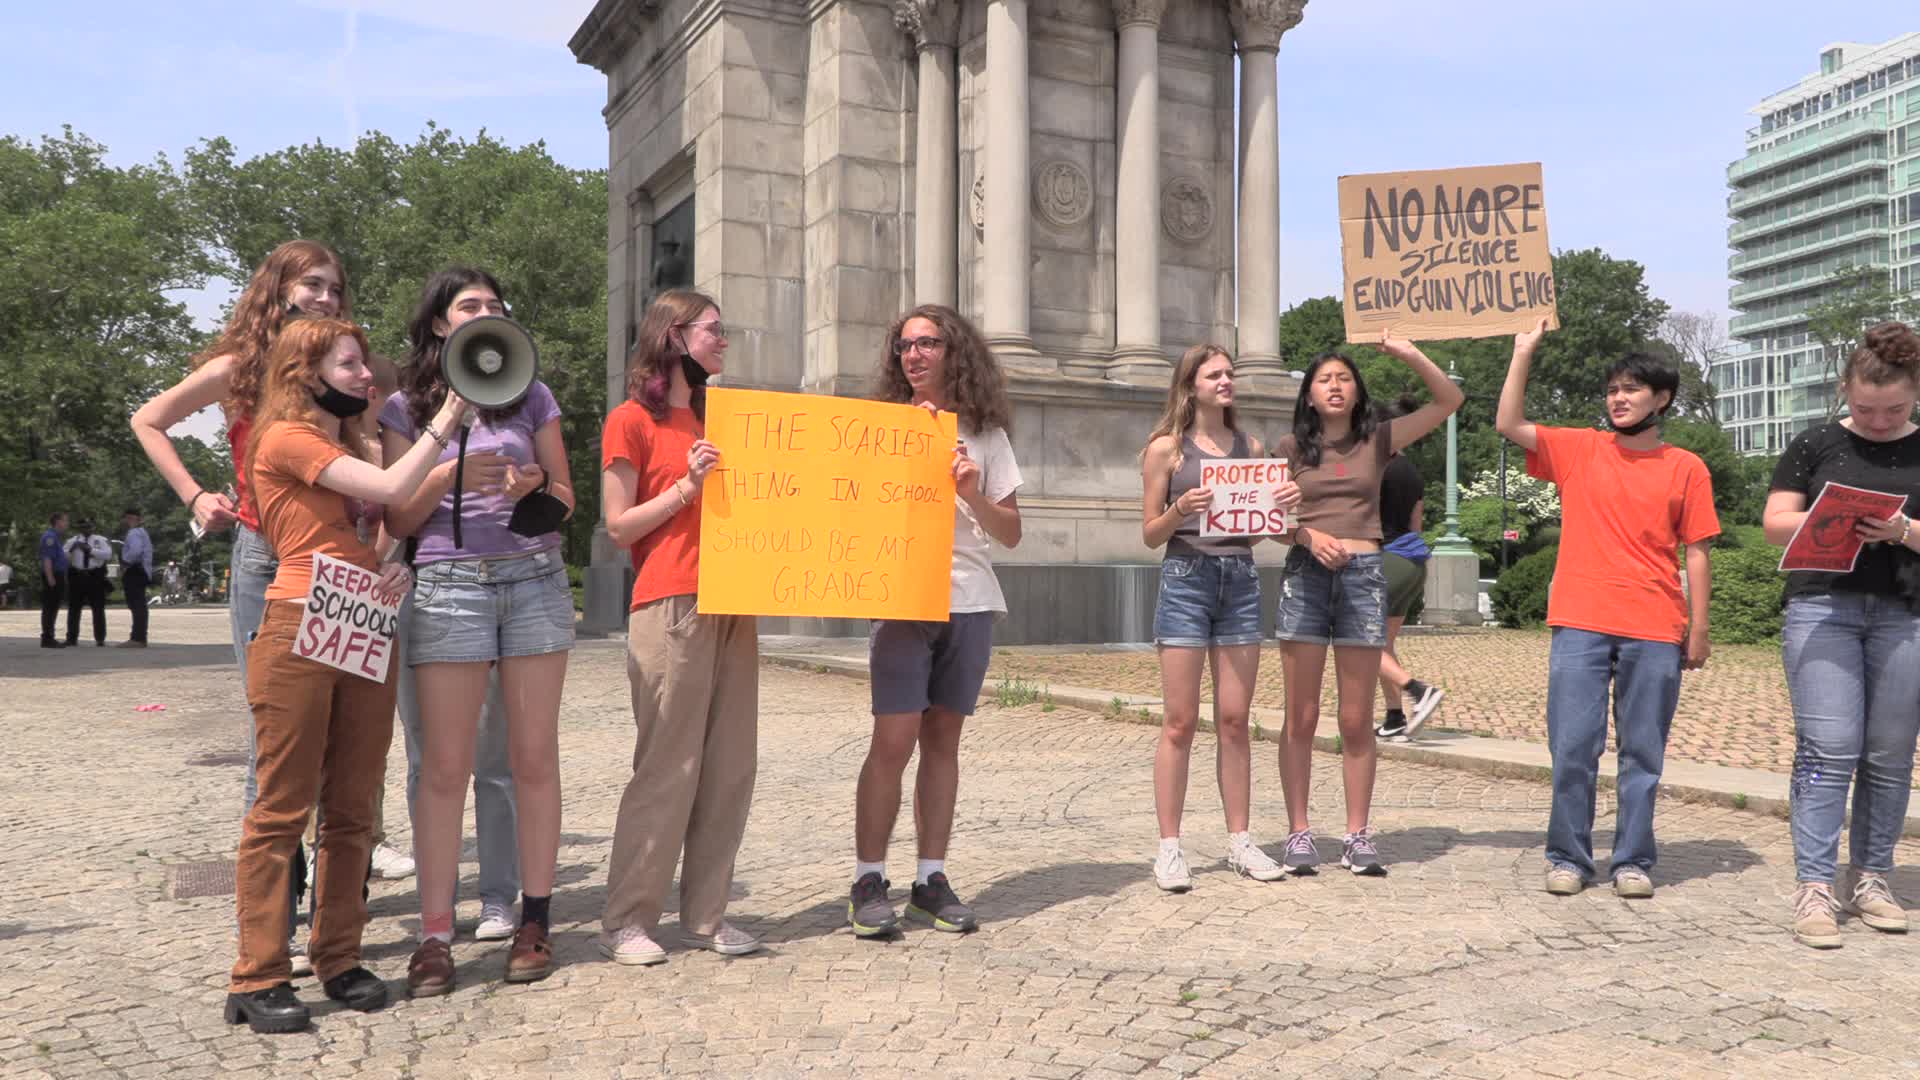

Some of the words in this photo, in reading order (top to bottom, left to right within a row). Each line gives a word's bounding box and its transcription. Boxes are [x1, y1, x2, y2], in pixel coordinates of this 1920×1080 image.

[1363, 187, 1425, 259] NO
[1433, 184, 1540, 242] MORE
[1400, 239, 1520, 278] SILENCE
[1353, 276, 1406, 312] END
[1407, 275, 1452, 313] GUN
[1452, 269, 1553, 316] VIOLENCE
[735, 413, 808, 451] THE
[827, 415, 935, 457] SCARIEST
[715, 468, 801, 500] THING
[829, 477, 860, 502] IN
[877, 481, 942, 503] SCHOOL
[1202, 463, 1288, 486] PROTECT
[1229, 490, 1259, 505] THE
[1206, 508, 1284, 534] KIDS
[712, 527, 813, 553] SHOULD
[827, 528, 860, 563] BE
[875, 535, 916, 561] MY
[315, 558, 372, 596] KEEP
[772, 565, 890, 604] GRADES
[308, 585, 398, 641] SCHOOLS
[299, 617, 387, 677] SAFE
